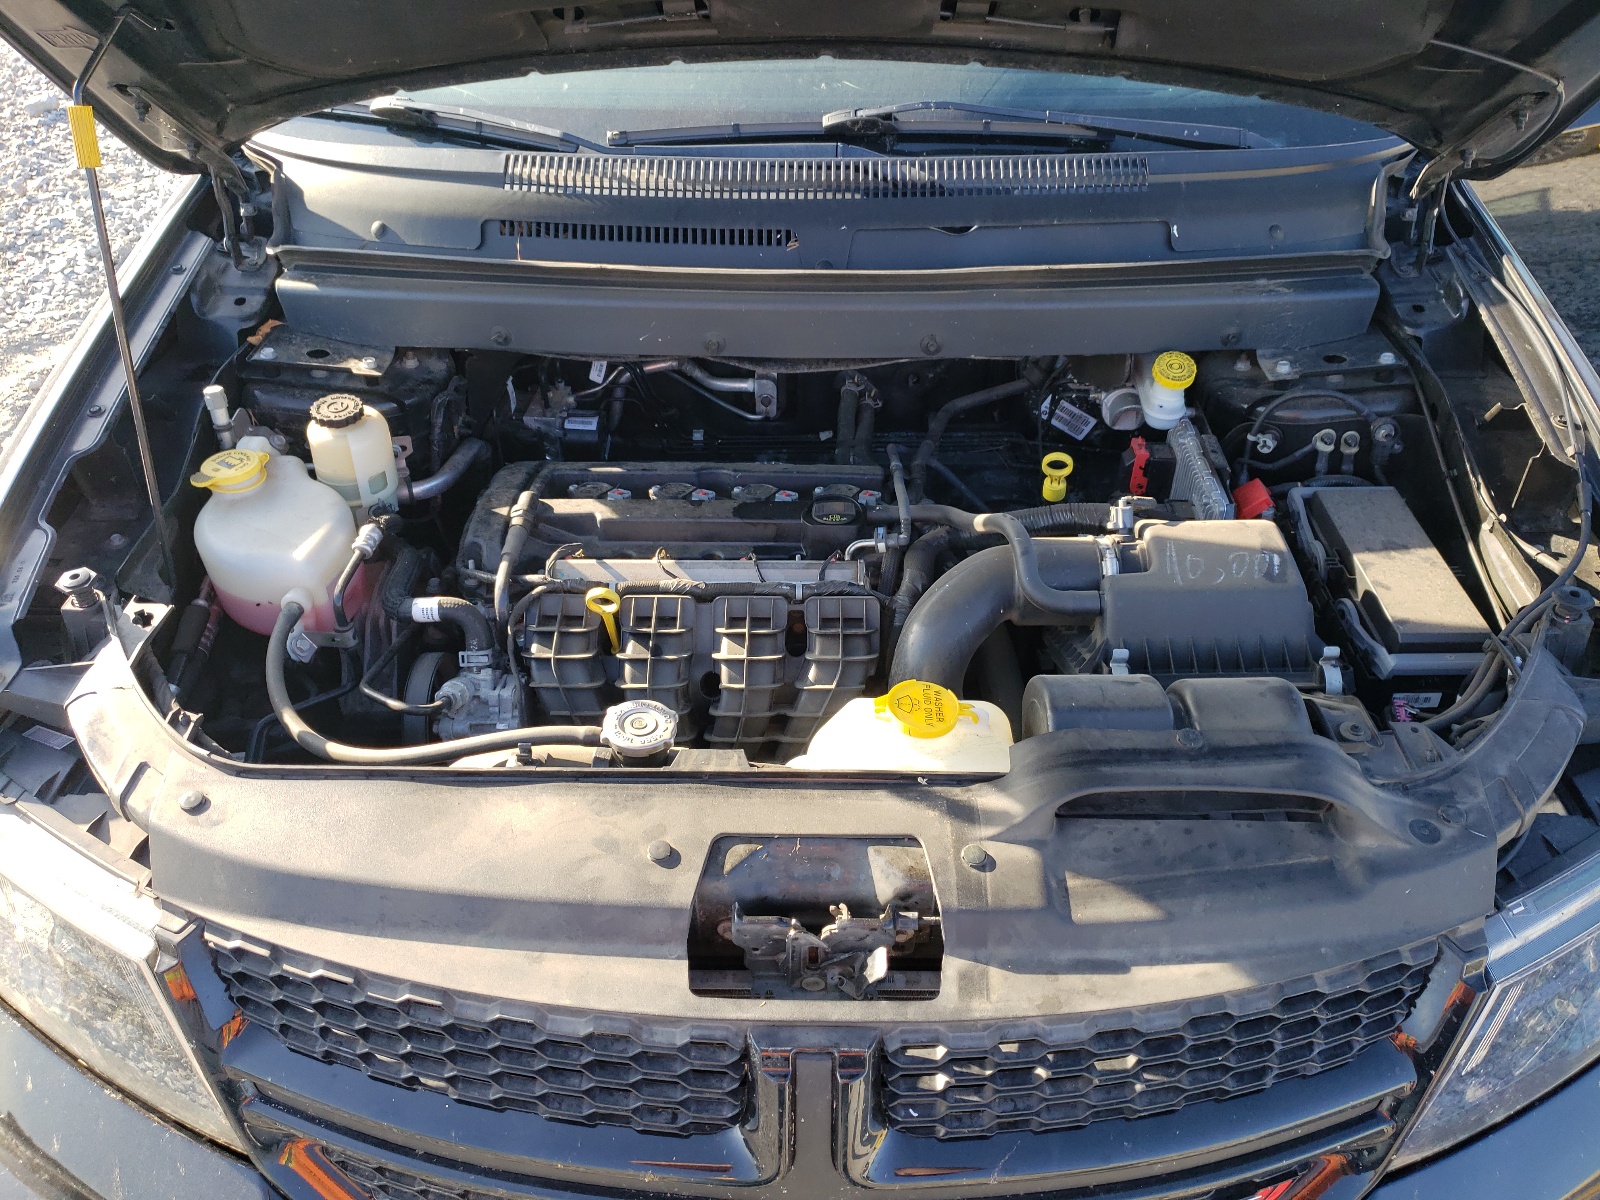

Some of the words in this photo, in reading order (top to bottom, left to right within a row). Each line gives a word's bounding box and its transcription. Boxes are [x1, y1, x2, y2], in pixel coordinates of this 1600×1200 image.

[922, 683, 932, 706] FLUID
[933, 689, 945, 723] WASHER
[924, 707, 935, 728] ONLY
